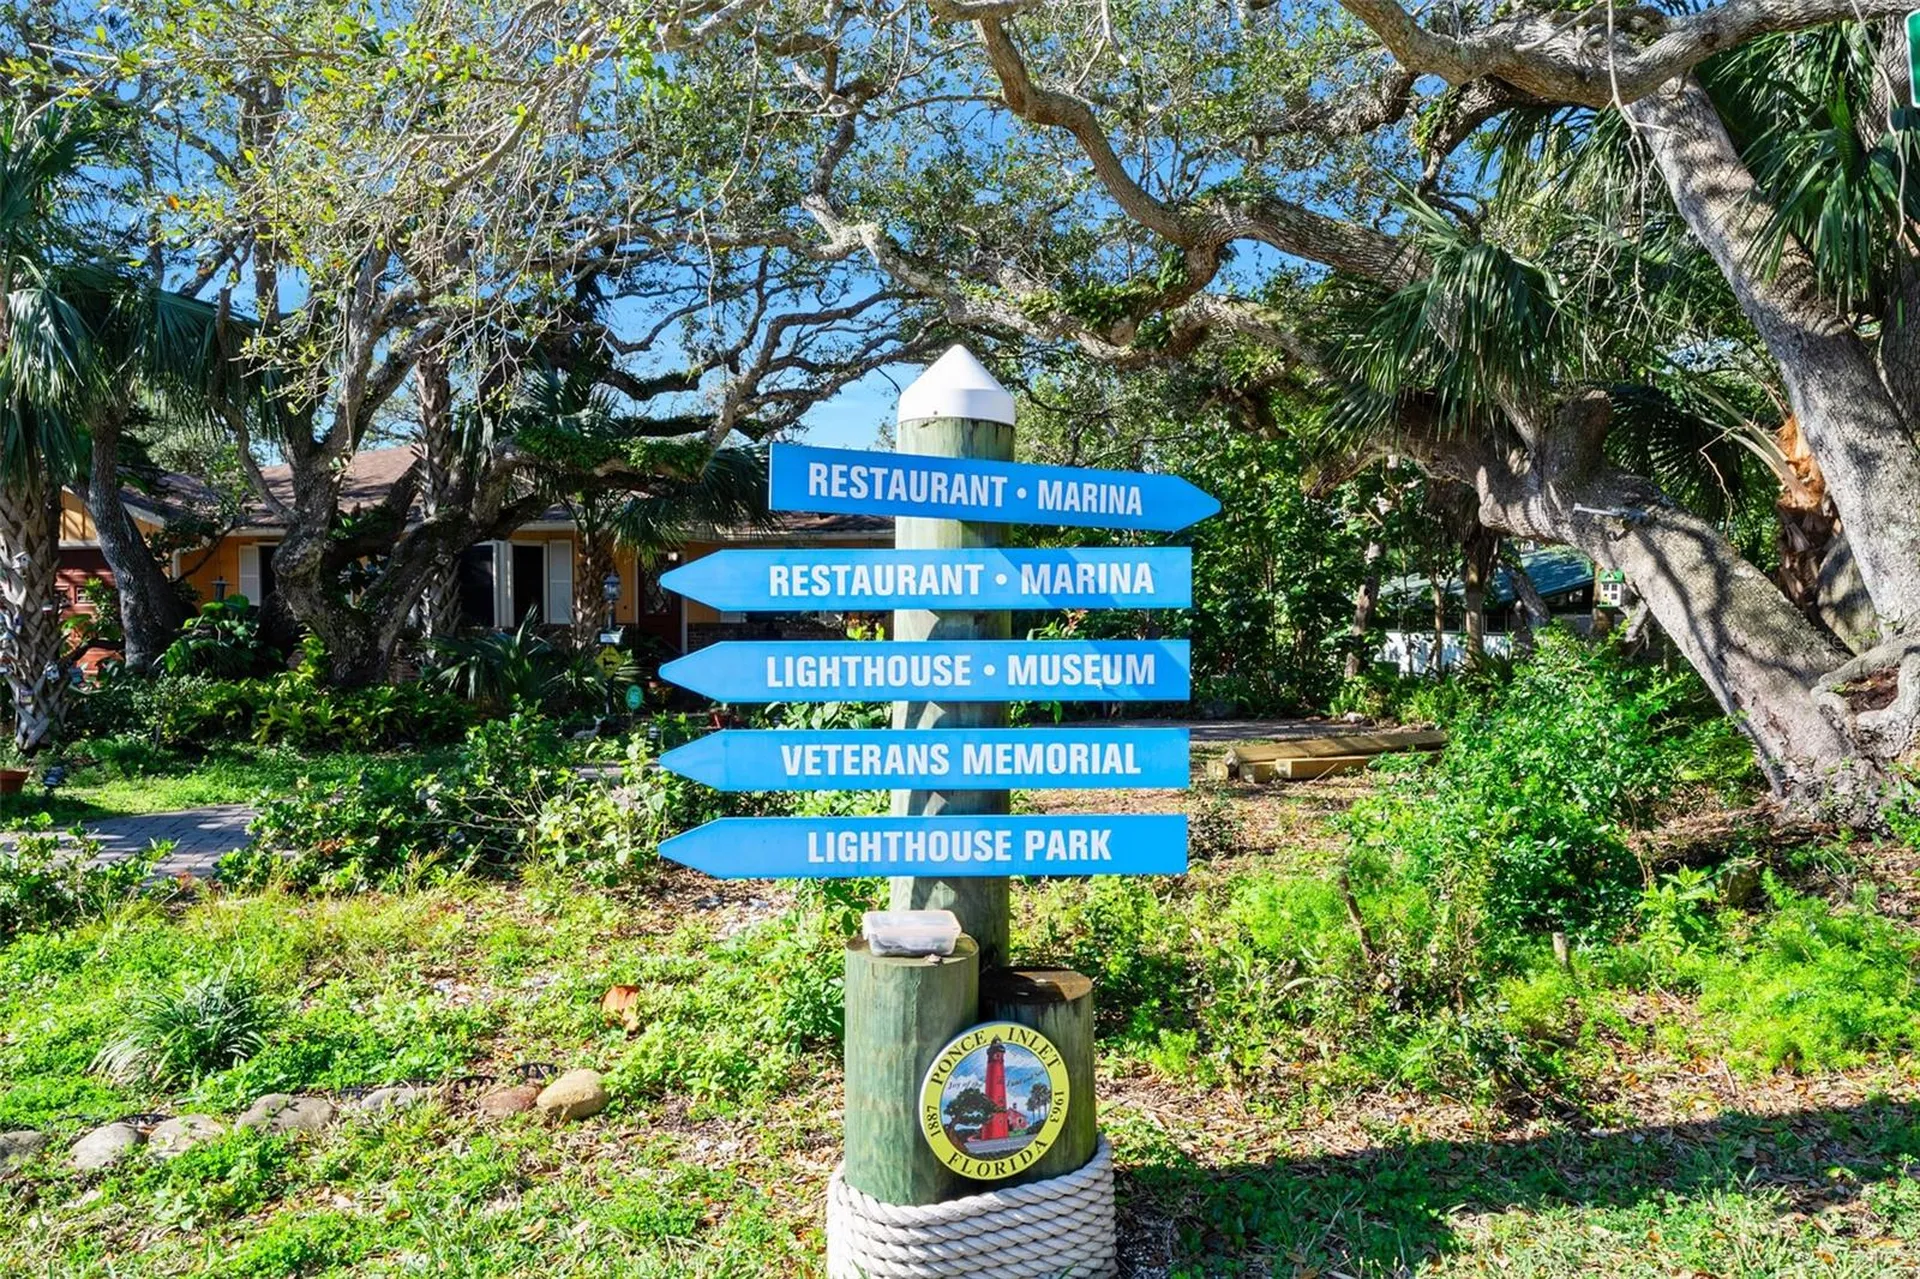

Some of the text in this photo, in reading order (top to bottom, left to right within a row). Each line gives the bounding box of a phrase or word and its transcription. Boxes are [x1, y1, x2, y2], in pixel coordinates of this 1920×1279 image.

[808, 463, 1143, 516] RESTAURANT MARINA
[769, 563, 1155, 597] RESTAURANT MARINA
[766, 654, 1155, 688] LIGHTHOUSE MUSEUM
[781, 743, 1141, 776] VETERANS MEMORIAL
[808, 830, 1111, 863] LIGHTHOUSE PARK
[930, 1027, 1061, 1086] PONCE INLET
[927, 1105, 941, 1137] 1887
[1050, 1091, 1065, 1123] 1963
[947, 1139, 1047, 1176] FLORIDA
